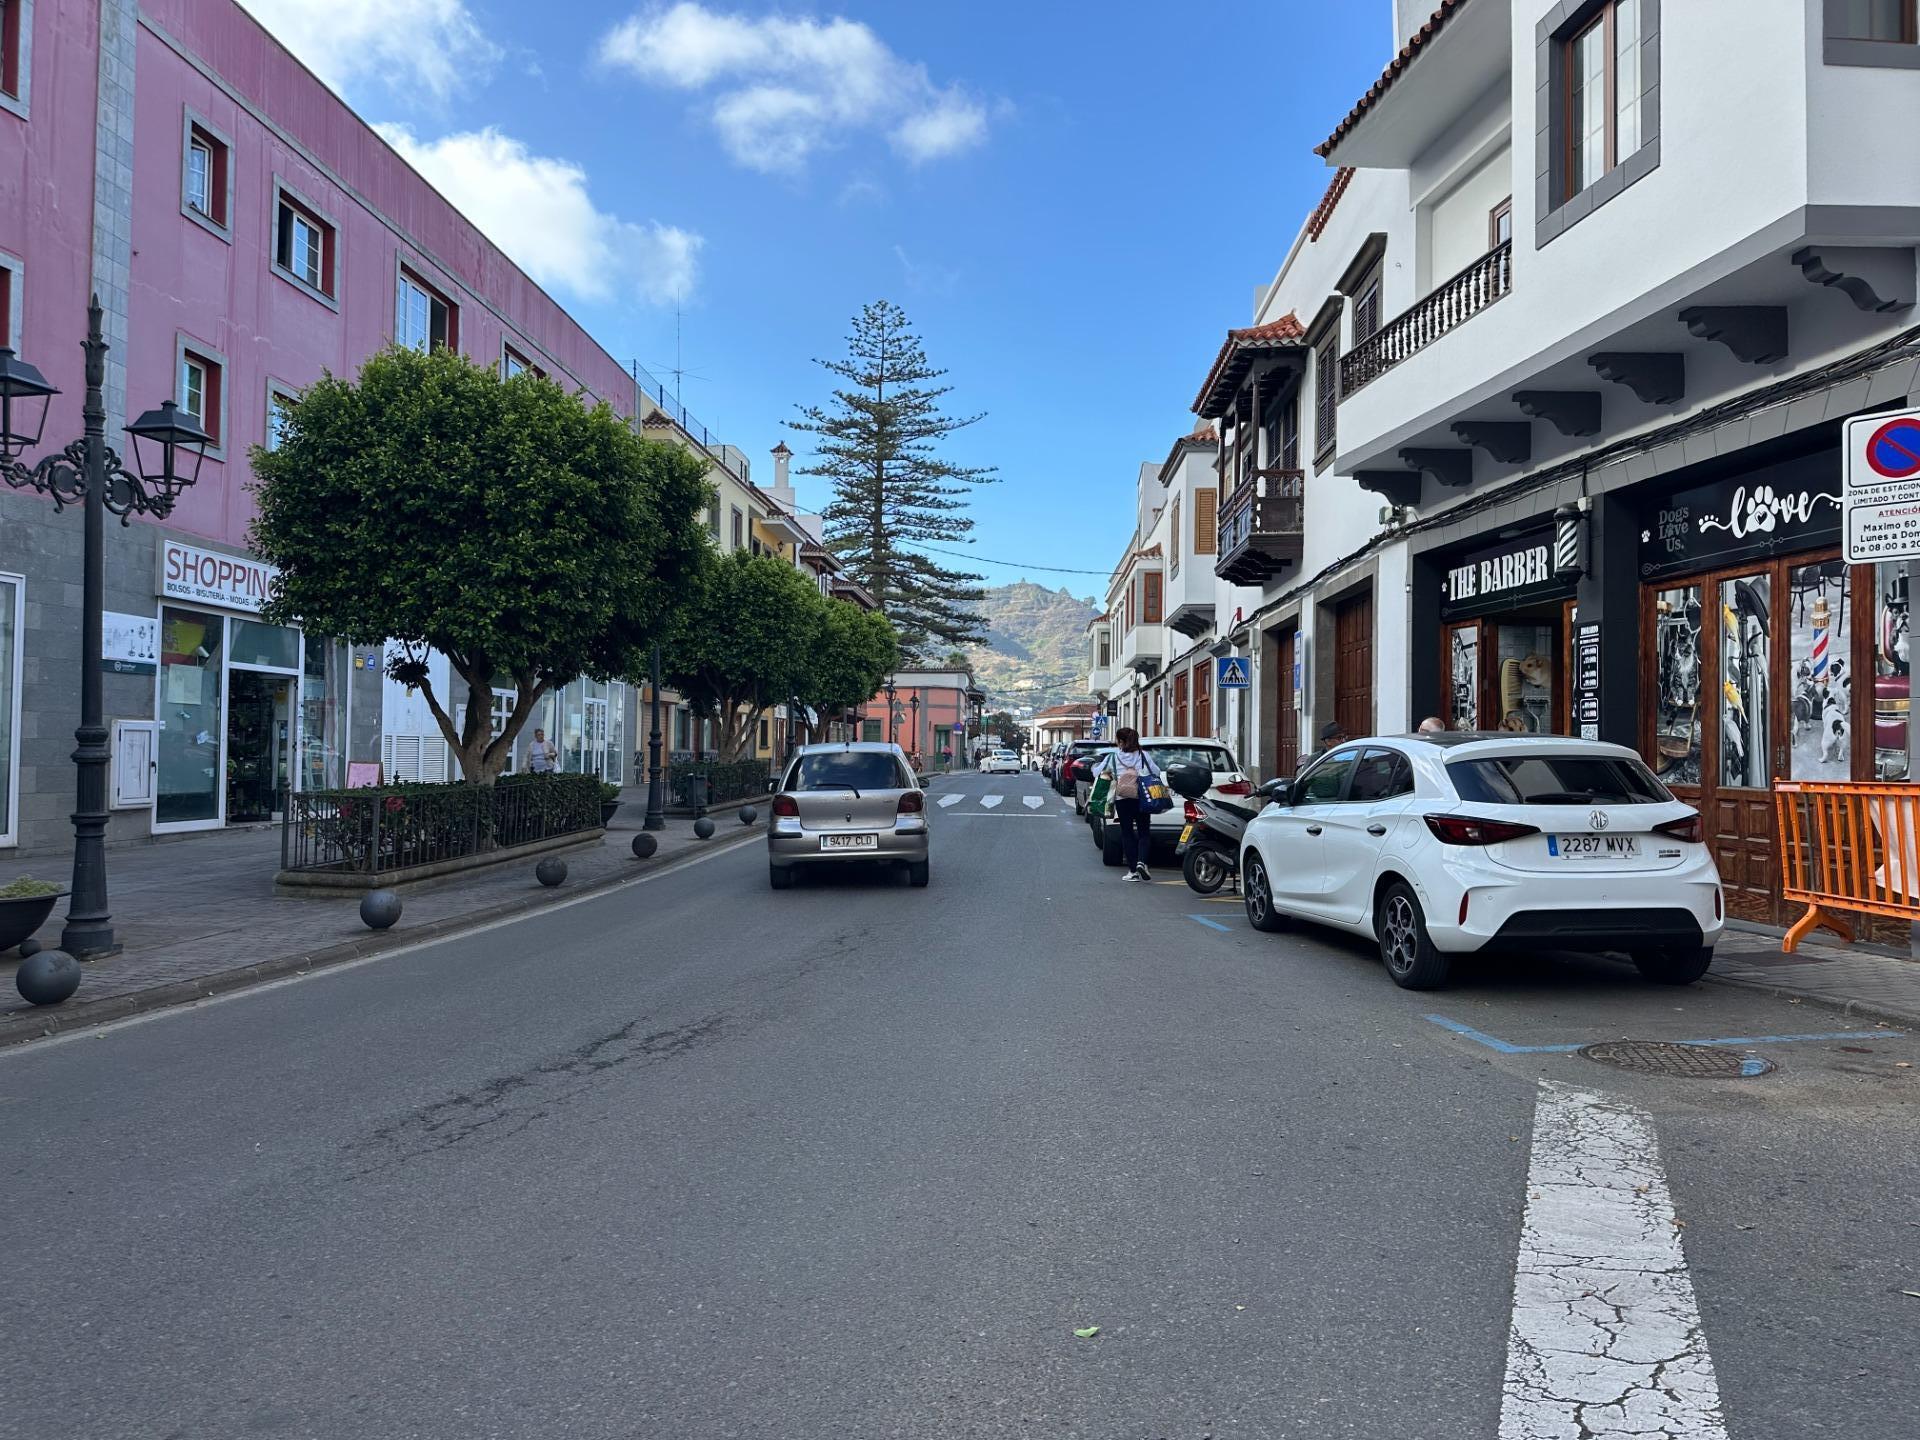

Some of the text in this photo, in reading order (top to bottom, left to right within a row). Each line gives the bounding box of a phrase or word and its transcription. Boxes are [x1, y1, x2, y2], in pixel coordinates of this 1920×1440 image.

[1848, 489, 1869, 497] ZONA
[1853, 495, 1889, 505] LIMITADO
[1879, 506, 1920, 517] ATENCIÓ
[1863, 519, 1917, 532] Maximo 60
[1860, 533, 1888, 543] Lunes
[1665, 537, 1685, 552] Us.
[1852, 545, 1865, 553] De
[1448, 564, 1477, 602] THE
[1480, 545, 1549, 595] BARBER
[167, 583, 191, 595] BOLSOS
[229, 595, 250, 606] MODAS
[1589, 809, 1609, 830] MG
[830, 837, 851, 846] 9417
[1562, 836, 1635, 853] 2287 MVX
